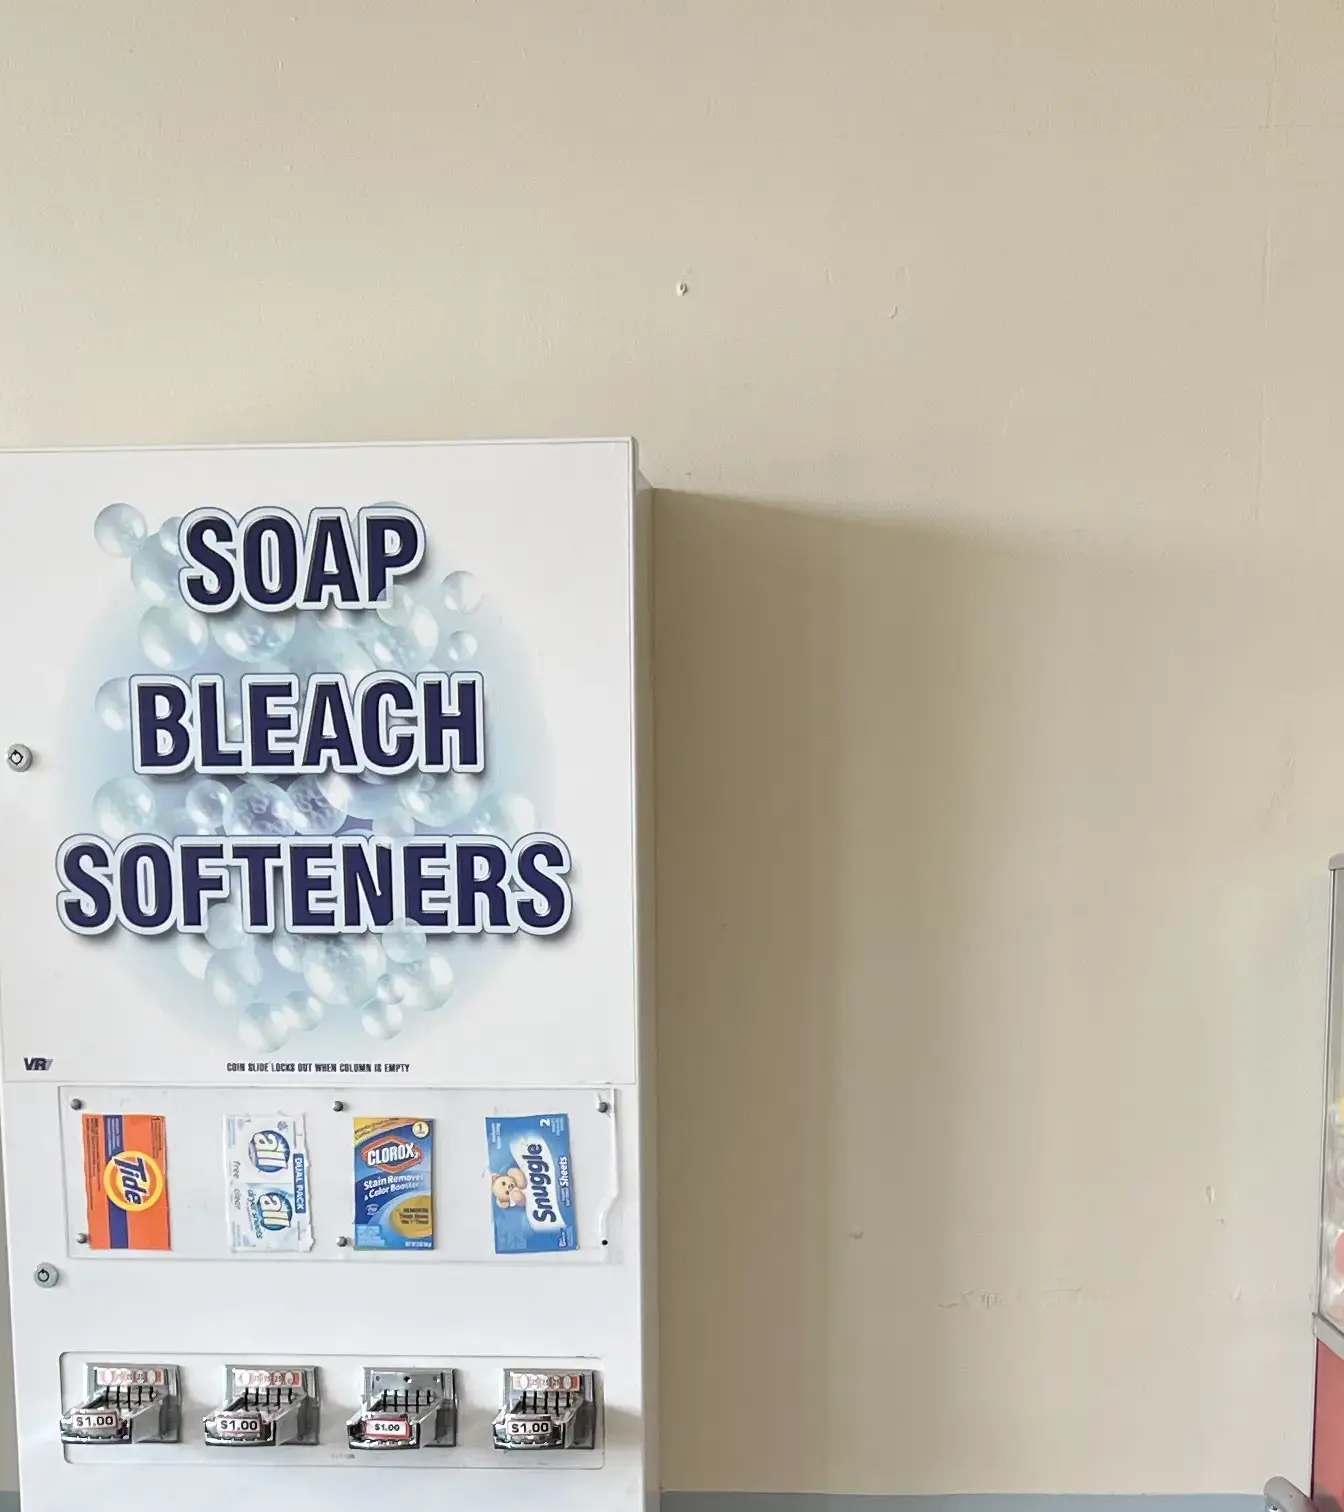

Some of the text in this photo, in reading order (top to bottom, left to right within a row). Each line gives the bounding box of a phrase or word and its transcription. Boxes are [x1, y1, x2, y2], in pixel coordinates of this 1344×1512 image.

[182, 510, 424, 609] SOAP
[132, 674, 483, 772] BLEACH
[59, 836, 570, 932] SOFTENERS
[227, 1063, 410, 1073] COIN SLIDE LOCKS OUT WHEN COLUMN IS EMPTY
[253, 1132, 288, 1169] all
[112, 1155, 148, 1206] Tide
[294, 1157, 305, 1210] DUAL PACK
[363, 1175, 387, 1190] Stain
[522, 1143, 557, 1223] Snuggle
[559, 1156, 568, 1187] Sheets
[368, 1185, 390, 1199] Color
[259, 1194, 292, 1228] all
[76, 1415, 114, 1427] $1.00
[220, 1419, 258, 1431] $1.00
[374, 1423, 400, 1432] $1.00
[511, 1422, 549, 1433] $1.00
